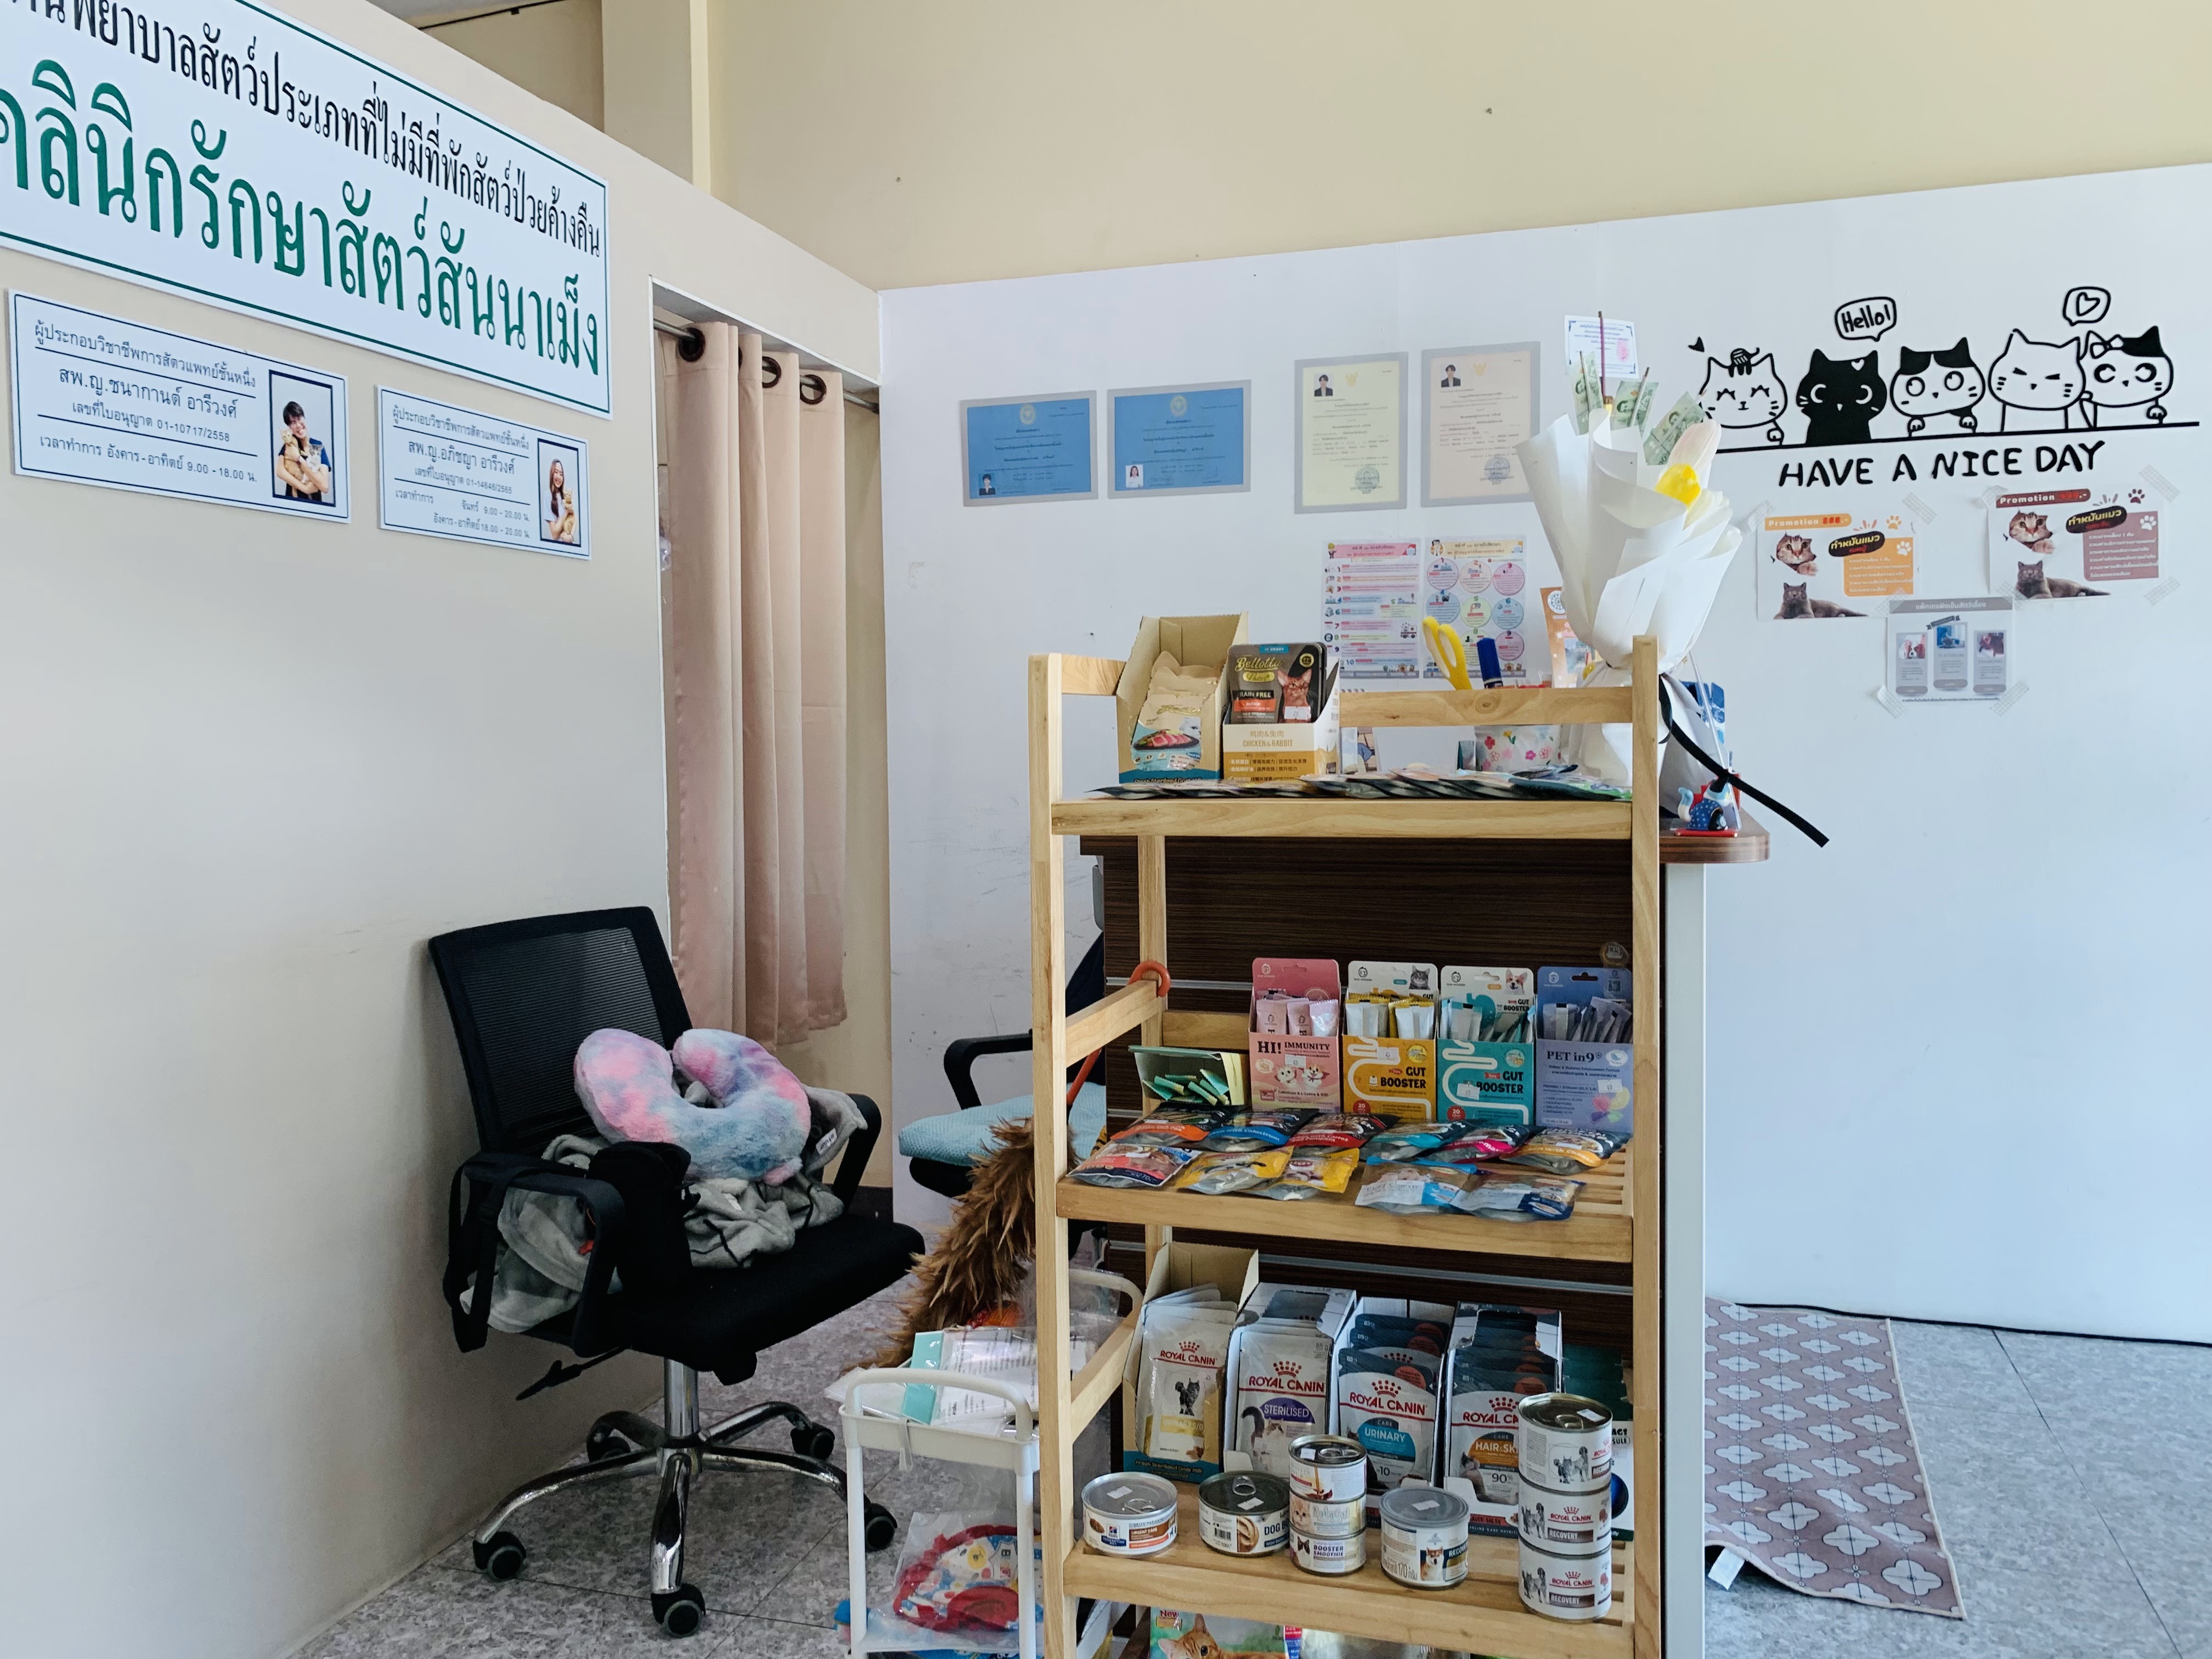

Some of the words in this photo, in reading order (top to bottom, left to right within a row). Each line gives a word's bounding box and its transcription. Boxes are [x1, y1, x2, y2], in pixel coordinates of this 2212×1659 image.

[13, 0, 600, 258] พยาบาลสัตว์ประเภทที่ไม่มีที่พักสัตว์ป่วยค้างคืน
[1841, 302, 1892, 332] Hello!
[35, 319, 256, 388] ผู้ประกอบวิชาชีพการสัตวแพทย์ชั้นหนึ่ง
[188, 397, 238, 419] อารีวงศ์
[72, 401, 153, 430] เลขที่ใบอนุญาต
[157, 419, 230, 442] 01-10717/2558
[392, 404, 530, 450] ผู้ประกอบวิชาชีพการสัตวแพทย์ชั้นหนึ่ง
[40, 436, 102, 458] เวลาทำการ
[188, 462, 208, 476] 9.00
[219, 467, 244, 481] 18.00
[1779, 457, 1874, 489] HAVE
[1892, 454, 1919, 482] A
[1931, 447, 2023, 482] NICE
[2036, 440, 2106, 474] DAY
[2000, 494, 2055, 505] Promotion
[1768, 518, 1819, 527] Promotion
[1235, 657, 1282, 672] Bellotta
[1257, 1041, 1282, 1054] HI!
[1284, 1041, 1330, 1051] IMMUNITY
[1547, 1051, 1571, 1061] PET
[1406, 1066, 1426, 1077] GUT
[1503, 1071, 1524, 1081] GUT
[1380, 1077, 1426, 1088] BOOSTER
[1476, 1082, 1524, 1094] BOOSTER
[1160, 1350, 1186, 1362] ROYAL
[1188, 1355, 1216, 1365] CANIN
[1248, 1376, 1284, 1390] ROYAL
[1287, 1379, 1325, 1392] CANIN
[1263, 1404, 1310, 1418] STERILISED
[1350, 1392, 1384, 1409] ROYAL
[1387, 1400, 1426, 1417] CANIN
[1463, 1410, 1500, 1424] ROYAL
[1364, 1427, 1406, 1443] URINARY
[1379, 1466, 1391, 1476] 10
[1550, 1513, 1570, 1522] ROYAL
[1265, 1523, 1280, 1536] DOG
[1549, 1530, 1578, 1541] RECOVERY
[1313, 1544, 1344, 1552] BOOSTER
[1398, 1562, 1408, 1578] 170
[1551, 1577, 1572, 1587] ROYAL
[1550, 1595, 1580, 1605] RECOVERY
[1160, 1610, 1180, 1618] New
